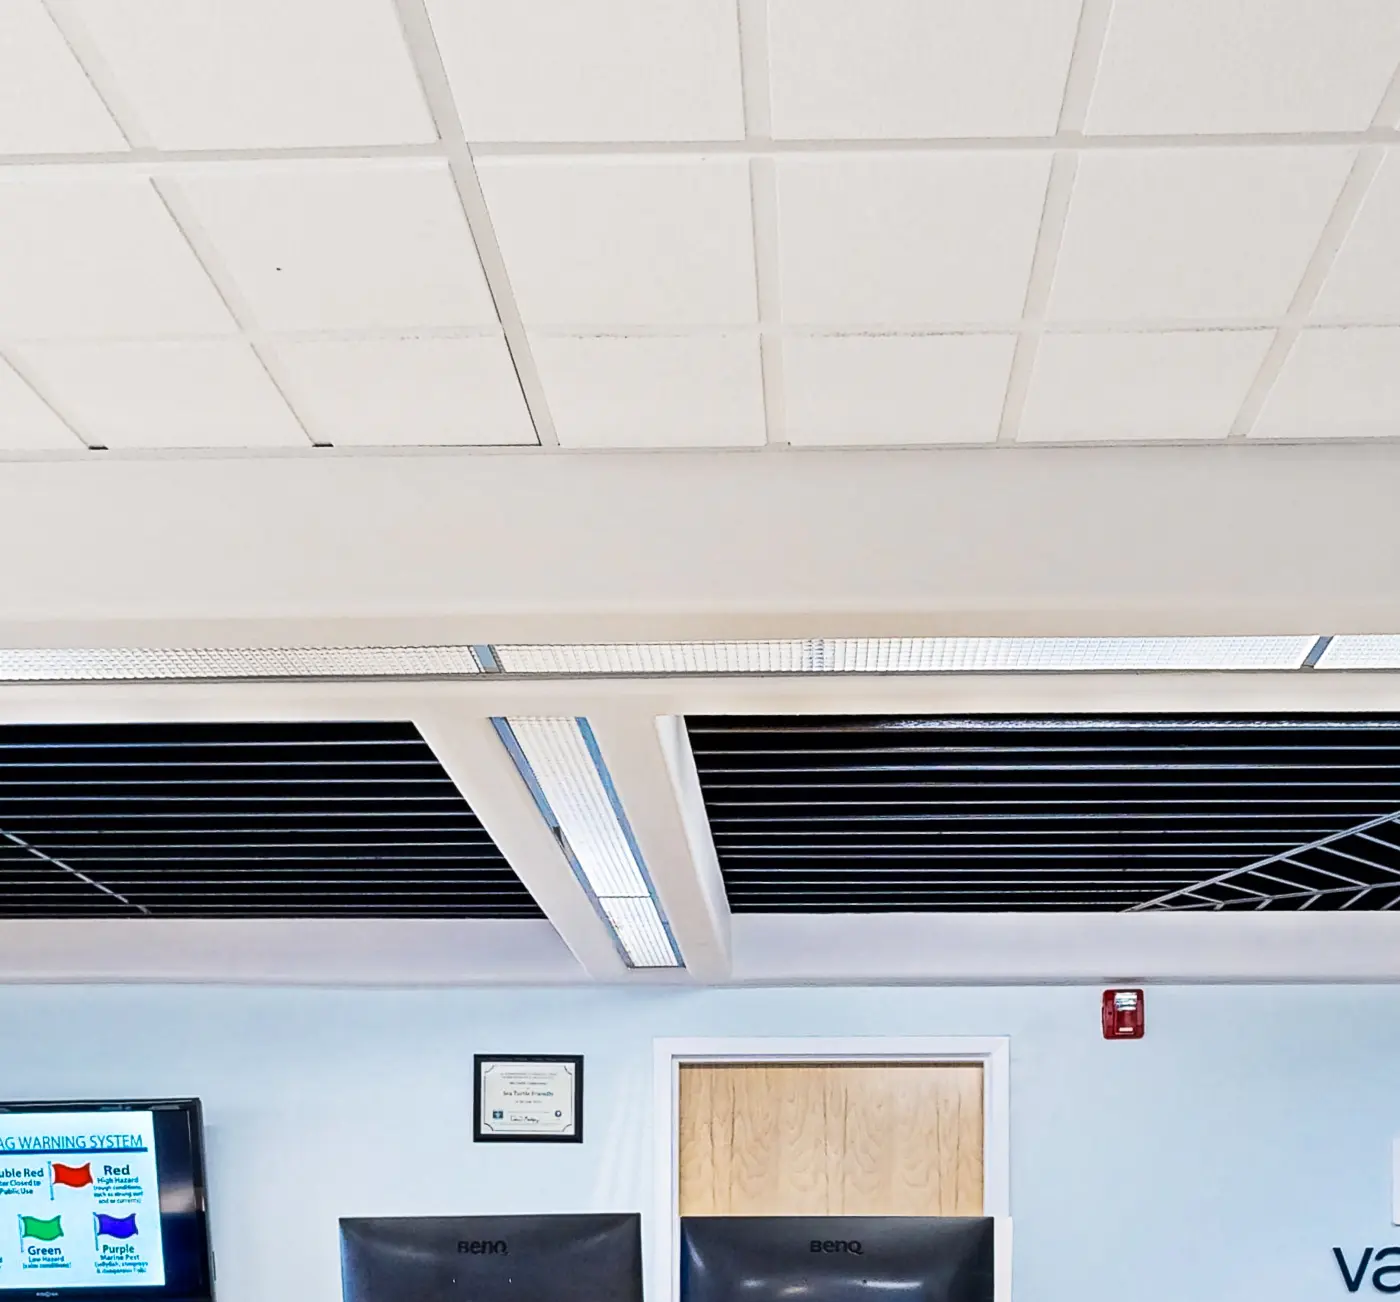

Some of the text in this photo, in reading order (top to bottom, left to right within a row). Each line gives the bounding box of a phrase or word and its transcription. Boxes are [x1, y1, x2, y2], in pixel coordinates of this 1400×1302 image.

[18, 1135, 86, 1149] WARNING
[90, 1134, 143, 1148] SYSTEM
[23, 1167, 44, 1177] Red
[103, 1164, 131, 1176] Red
[9, 1179, 32, 1187] Closed
[21, 1187, 34, 1195] Use
[28, 1246, 62, 1256] Green
[103, 1244, 135, 1255] Purple
[457, 1240, 508, 1256] BenQ
[810, 1240, 864, 1255] BenQ
[1332, 1247, 1400, 1293] va
